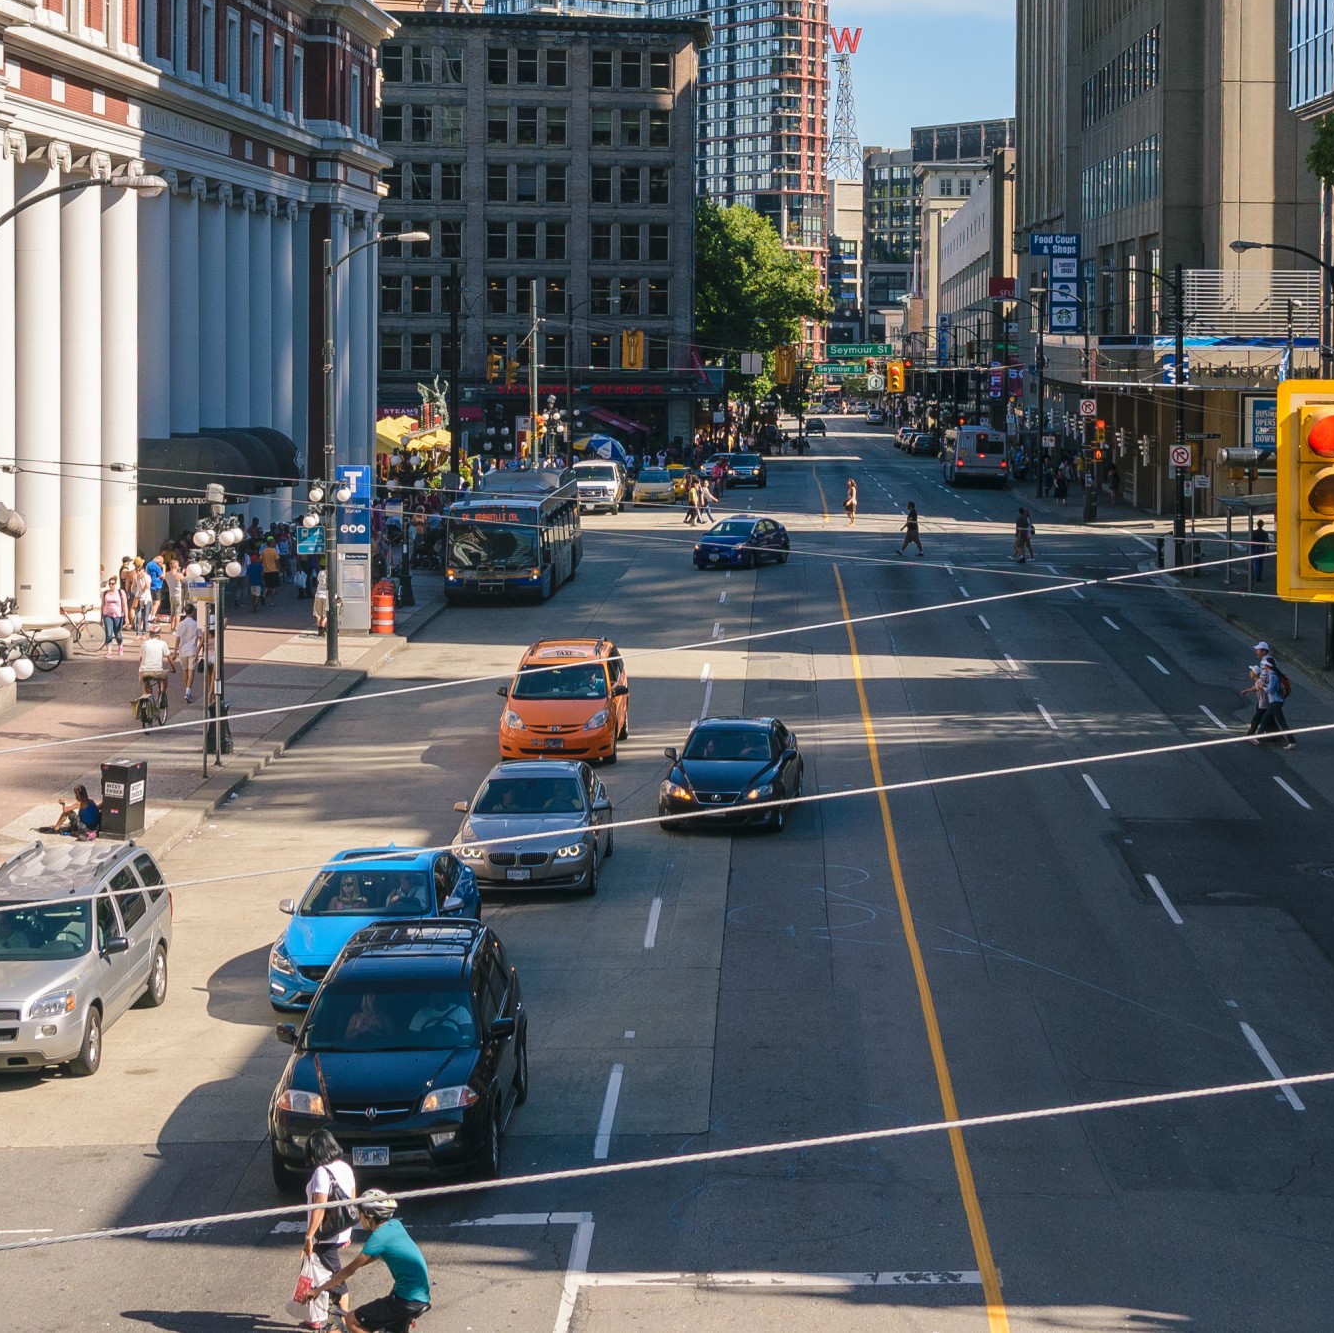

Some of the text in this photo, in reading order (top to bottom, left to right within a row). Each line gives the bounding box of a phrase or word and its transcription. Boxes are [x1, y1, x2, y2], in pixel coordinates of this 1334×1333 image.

[831, 27, 863, 54] W
[1034, 235, 1076, 244] Food Court
[1043, 245, 1076, 255] & Shops
[830, 345, 888, 355] Seymour St
[817, 365, 850, 373] Seymour
[1255, 410, 1277, 418] BUSIN
[1255, 434, 1276, 443] DOWN
[176, 497, 208, 505] STATIO
